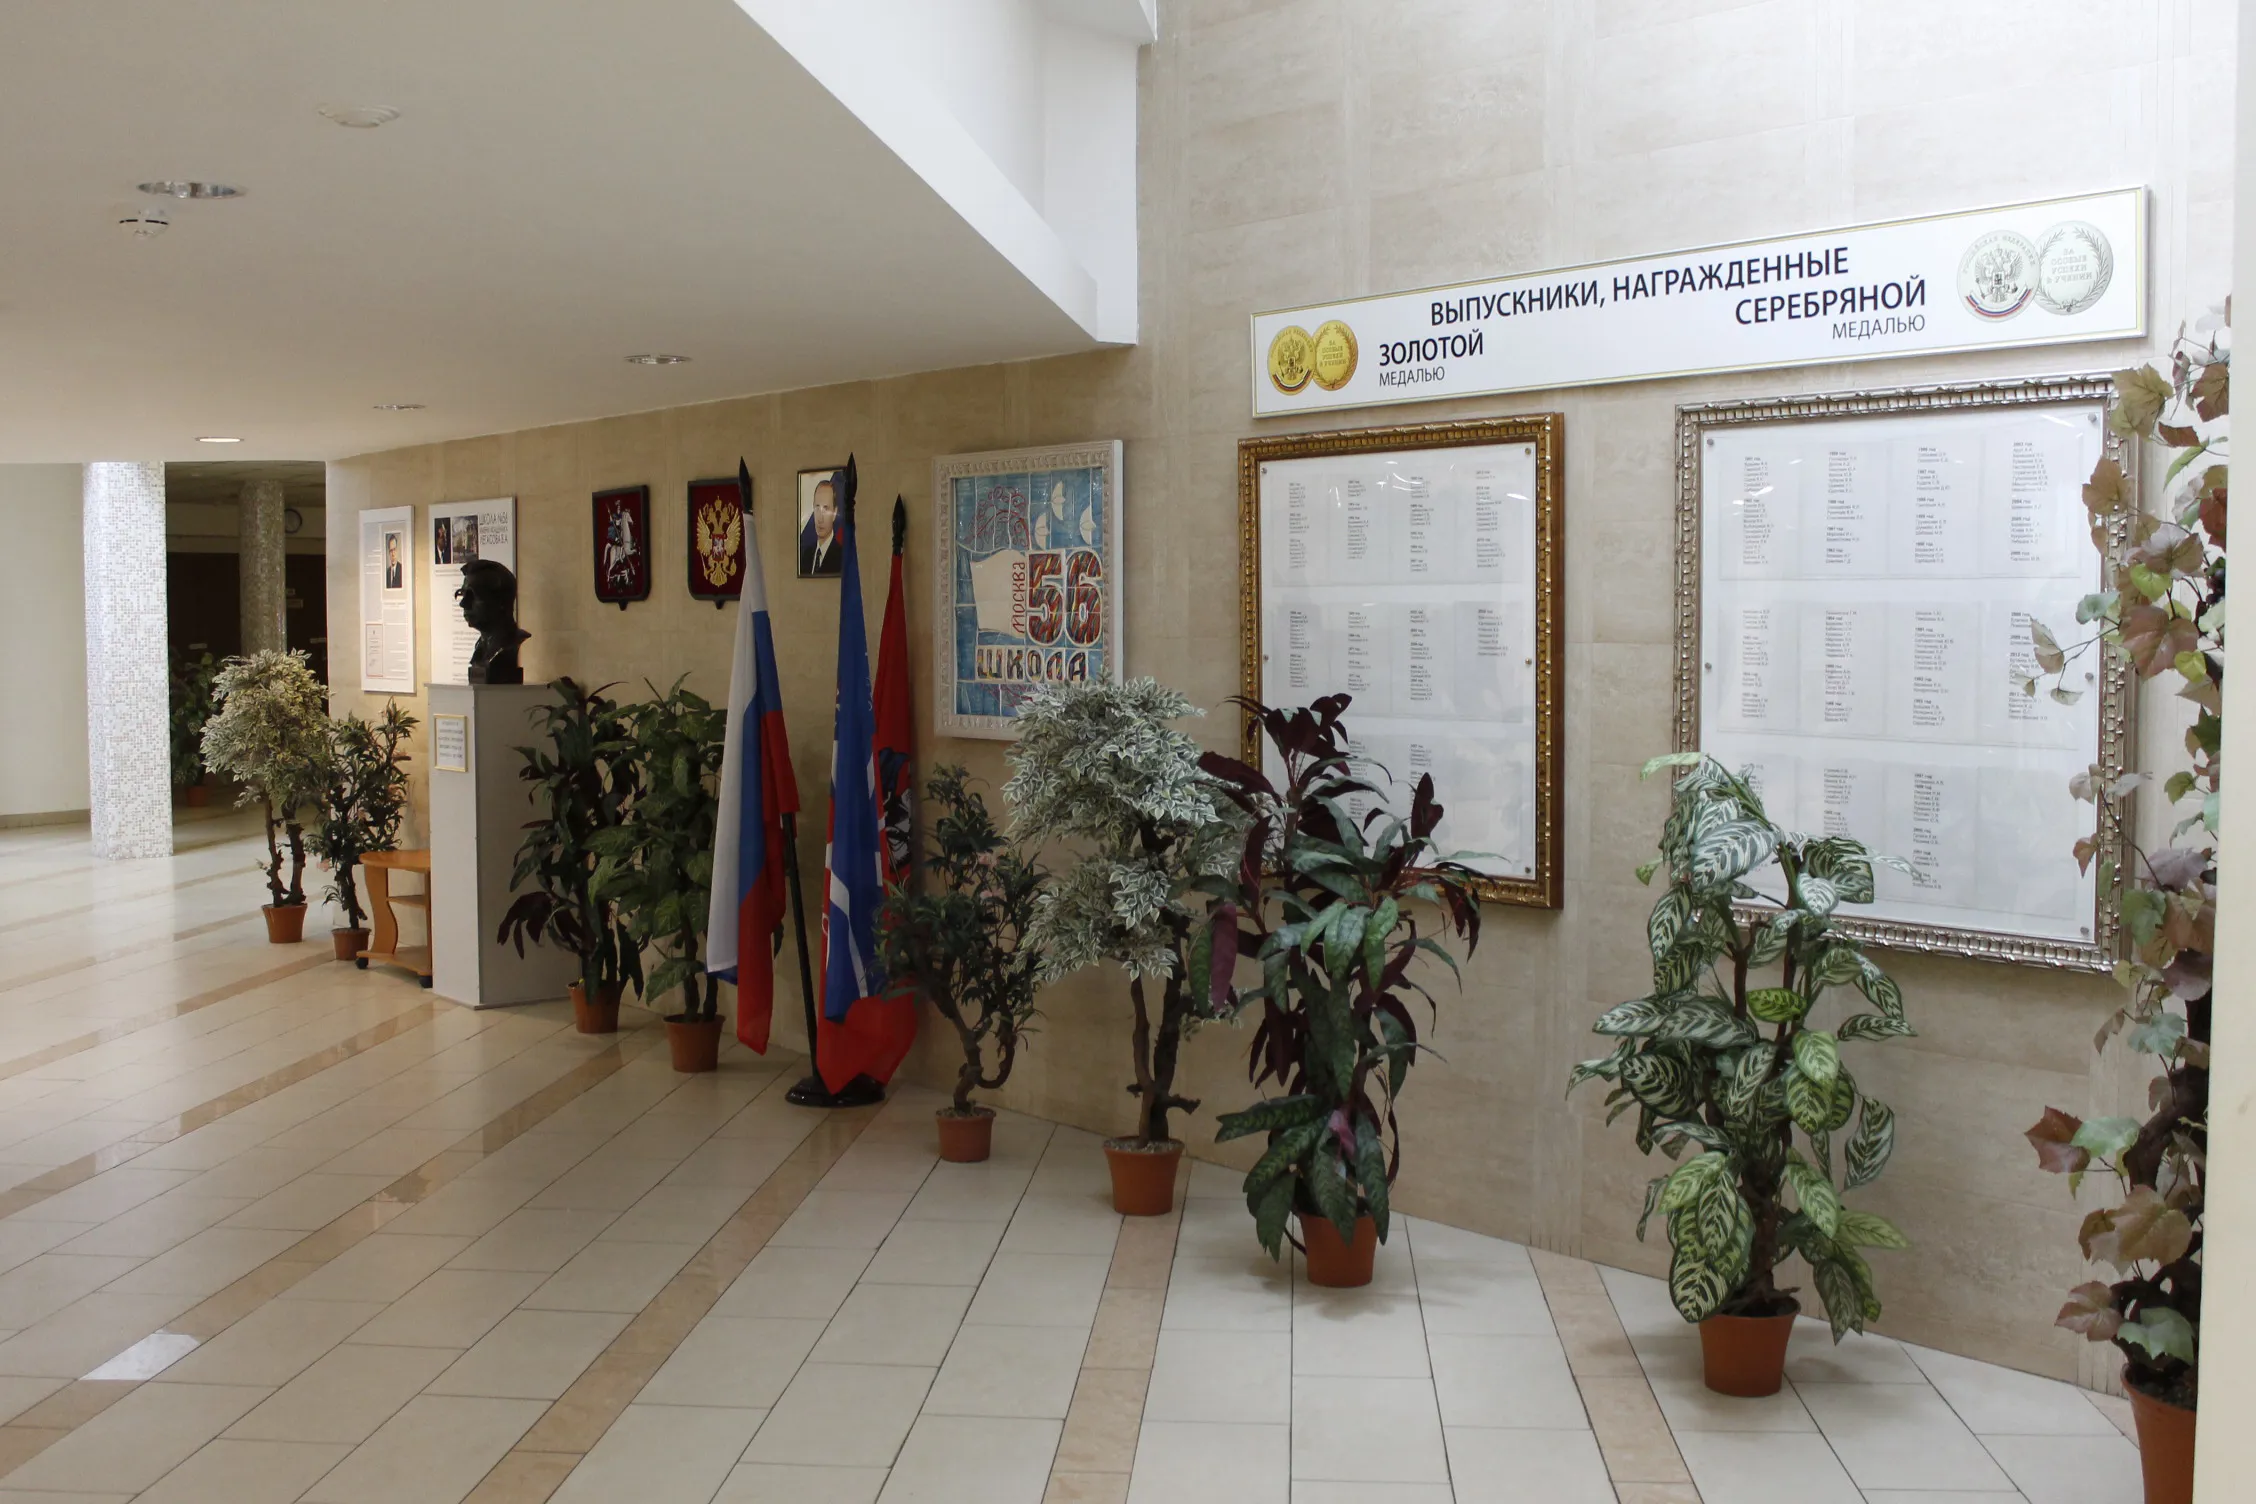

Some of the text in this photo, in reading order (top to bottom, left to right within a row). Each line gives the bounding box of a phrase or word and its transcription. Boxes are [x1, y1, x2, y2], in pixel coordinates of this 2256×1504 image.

[1430, 246, 1849, 327] ВЫПУСКНИКИ, НАГРАЖДЕННЫЕ
[1734, 274, 1926, 326] СЕРЕБРЯНОЙ
[1832, 313, 1926, 340] МЕДАЛЬЮ
[1379, 328, 1484, 367] ЗОЛОТОЙ
[1379, 366, 1445, 388] МЕДАЛЬЮ
[1026, 550, 1103, 647] 56
[977, 648, 1088, 682] ШКОЛА
